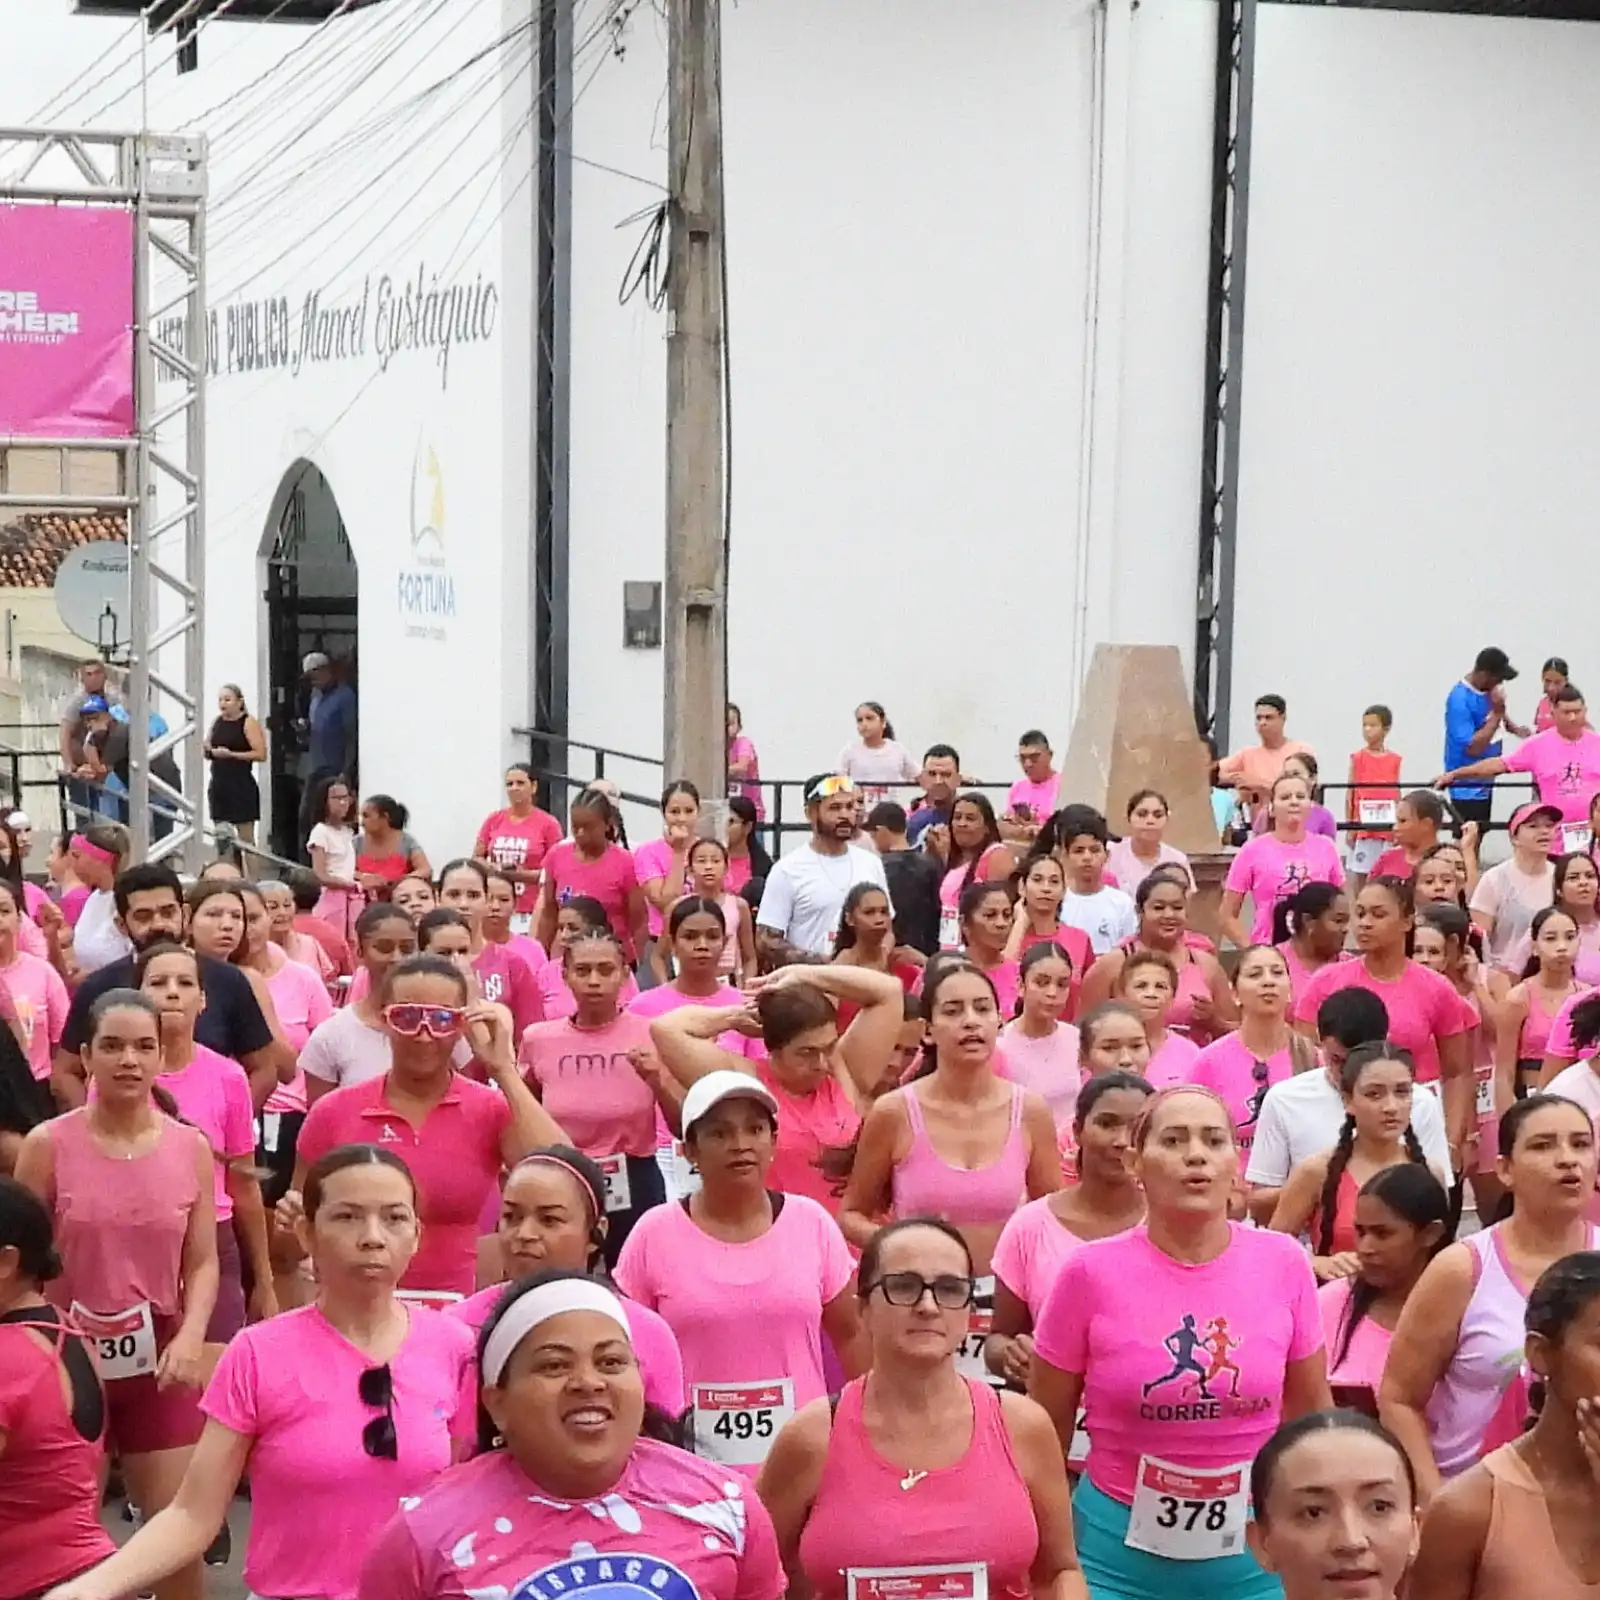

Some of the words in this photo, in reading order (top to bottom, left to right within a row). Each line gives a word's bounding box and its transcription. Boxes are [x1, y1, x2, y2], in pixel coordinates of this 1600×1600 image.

[399, 572, 457, 617] FORTUNA
[714, 1410, 774, 1440] 495
[1140, 1401, 1221, 1421] CORRE
[1156, 1496, 1227, 1532] 378
